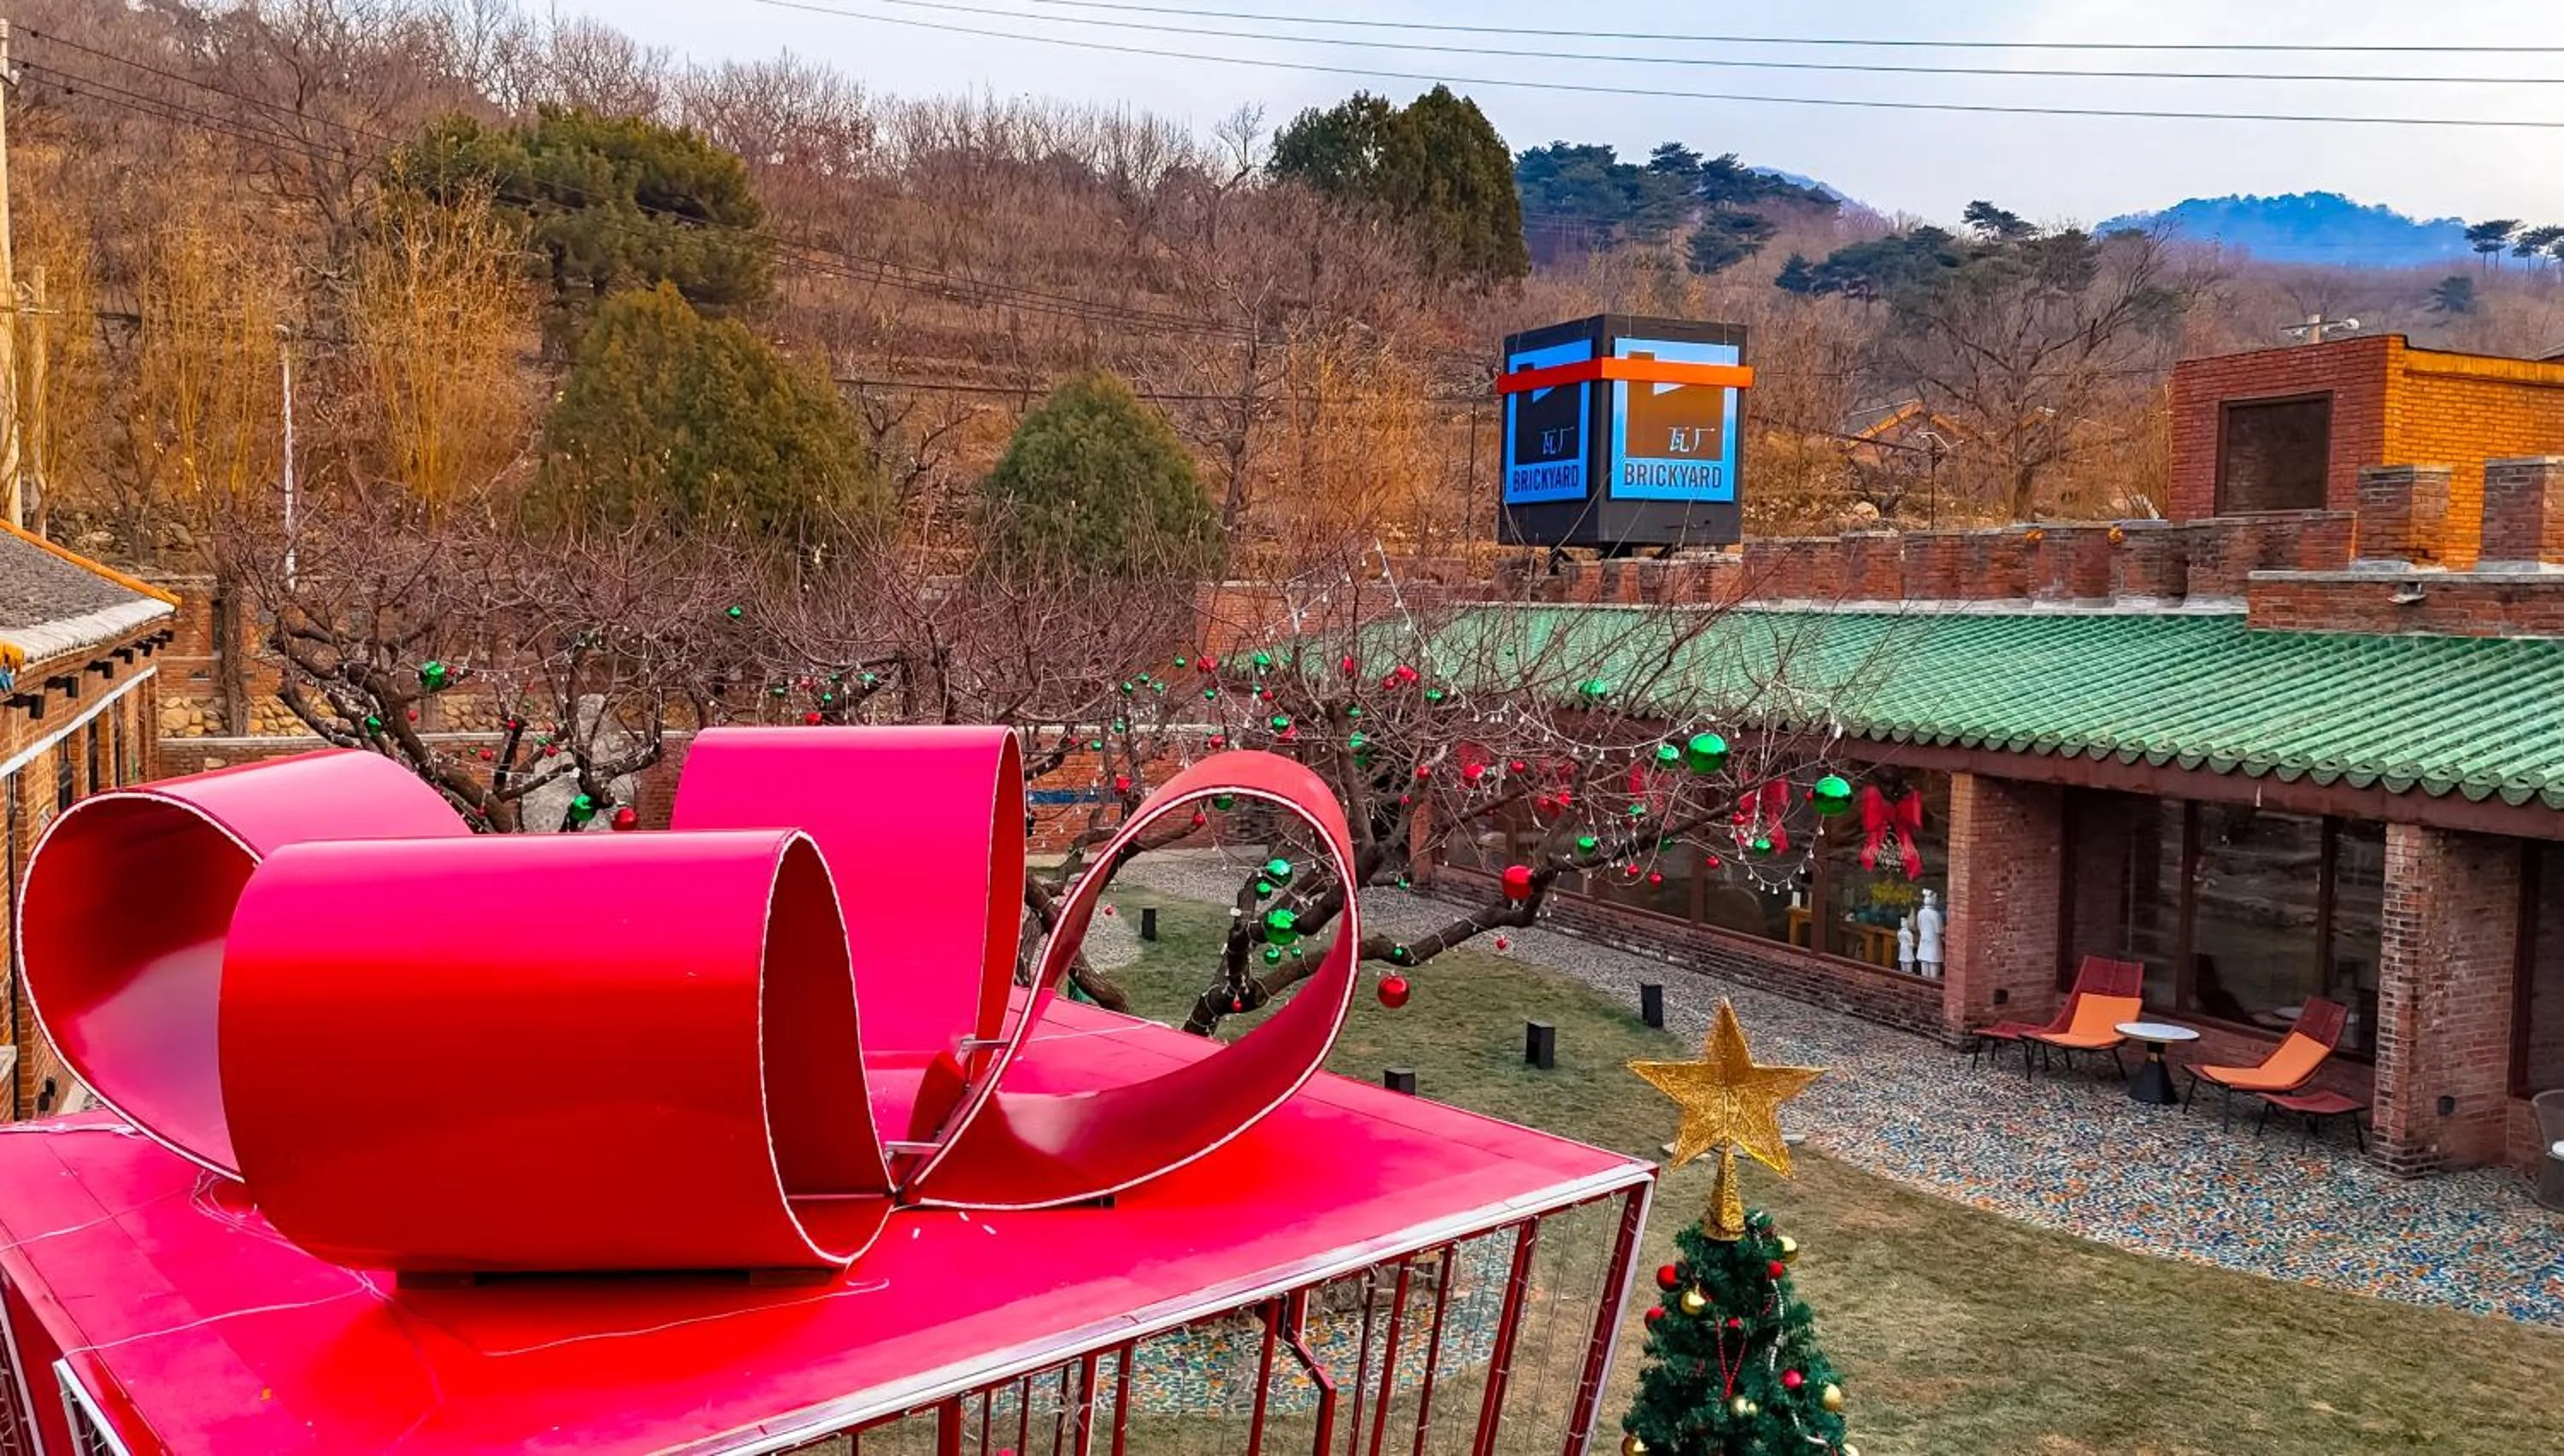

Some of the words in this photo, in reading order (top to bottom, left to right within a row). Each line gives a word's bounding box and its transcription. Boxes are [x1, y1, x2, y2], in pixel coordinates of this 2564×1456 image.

[1541, 426, 1574, 455] 瓦厂
[1668, 426, 1716, 453] 瓦厂
[1513, 464, 1579, 492] BRICKYARD
[1624, 463, 1723, 489] BRICKYARD
